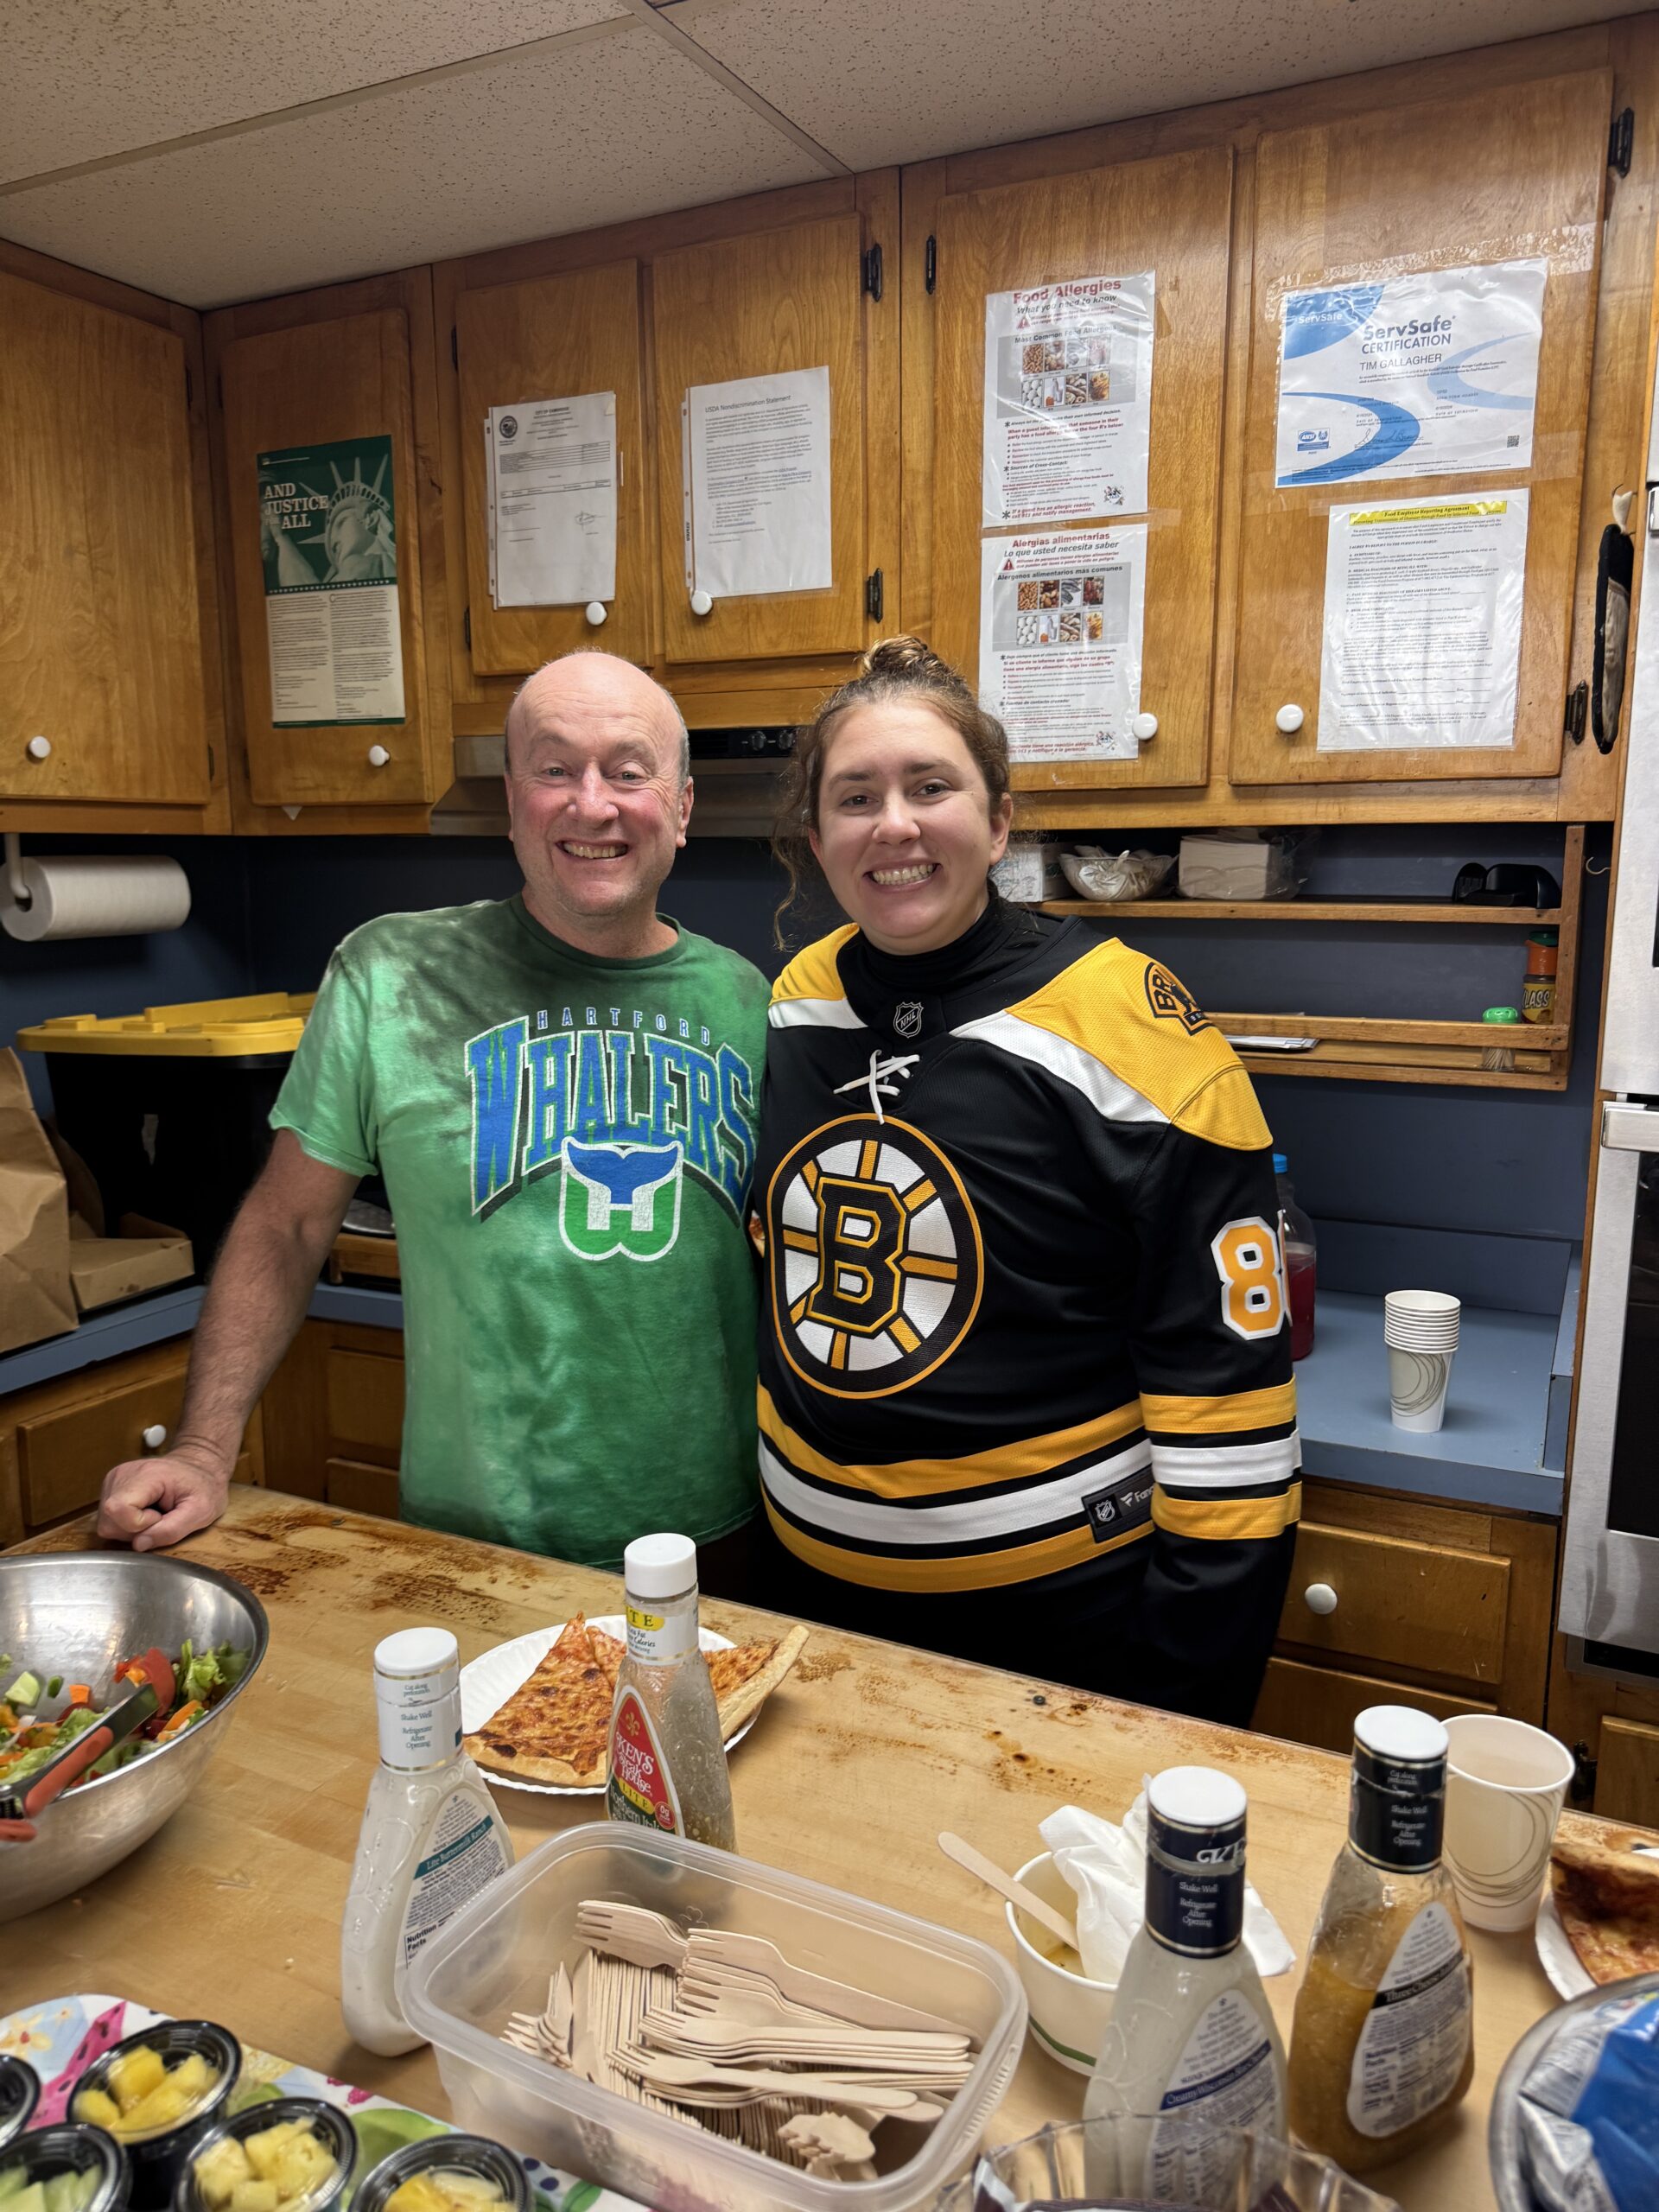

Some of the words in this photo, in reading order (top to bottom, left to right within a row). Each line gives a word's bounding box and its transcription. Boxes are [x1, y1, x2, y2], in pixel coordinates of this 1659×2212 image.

[1013, 289, 1048, 305] Food
[1055, 280, 1122, 299] Allergies
[1017, 306, 1039, 315] What
[1092, 295, 1117, 304] know
[1298, 313, 1343, 324] ServSafe
[1033, 332, 1062, 341] Common
[1363, 315, 1452, 341] ServSafe
[1361, 334, 1452, 354] CERTIFICATION
[1359, 361, 1377, 371] TIM
[1379, 353, 1442, 369] GALLAGHER
[264, 483, 296, 499] AND
[264, 495, 328, 515] JUSTICE
[281, 513, 312, 530] ALL
[1012, 537, 1050, 548] Alergias
[1052, 532, 1110, 544] alimentarias
[1015, 549, 1031, 558] que
[1033, 546, 1056, 555] usted
[1058, 543, 1093, 552] necesita
[1095, 541, 1120, 550] saber
[1032, 569, 1073, 578] alimentarios
[1090, 564, 1122, 574] comunes
[537, 1007, 710, 1046] HARTFORD
[464, 1014, 755, 1217] WHALERS
[1211, 1217, 1294, 1341] 8
[419, 1710, 433, 1719] Well
[405, 1740, 431, 1749] Opening
[615, 1731, 655, 1776] KEN'S
[621, 1764, 652, 1793] House
[622, 1783, 649, 1808] LITE
[1390, 1804, 1412, 1814] Shake
[1413, 1804, 1428, 1815] Well
[1392, 1836, 1422, 1847] Opening
[1399, 1829, 1416, 1838] After
[426, 1858, 441, 1871] Lite
[439, 1834, 473, 1863] Buttermilk
[1179, 1881, 1201, 1892] Shake
[1202, 1884, 1218, 1893] Well
[1182, 1916, 1213, 1928] Opening
[1187, 1909, 1206, 1918] After
[407, 1924, 437, 1943] Nutrition
[407, 1938, 427, 1952] Facts
[1166, 2087, 1197, 2105] Creamy
